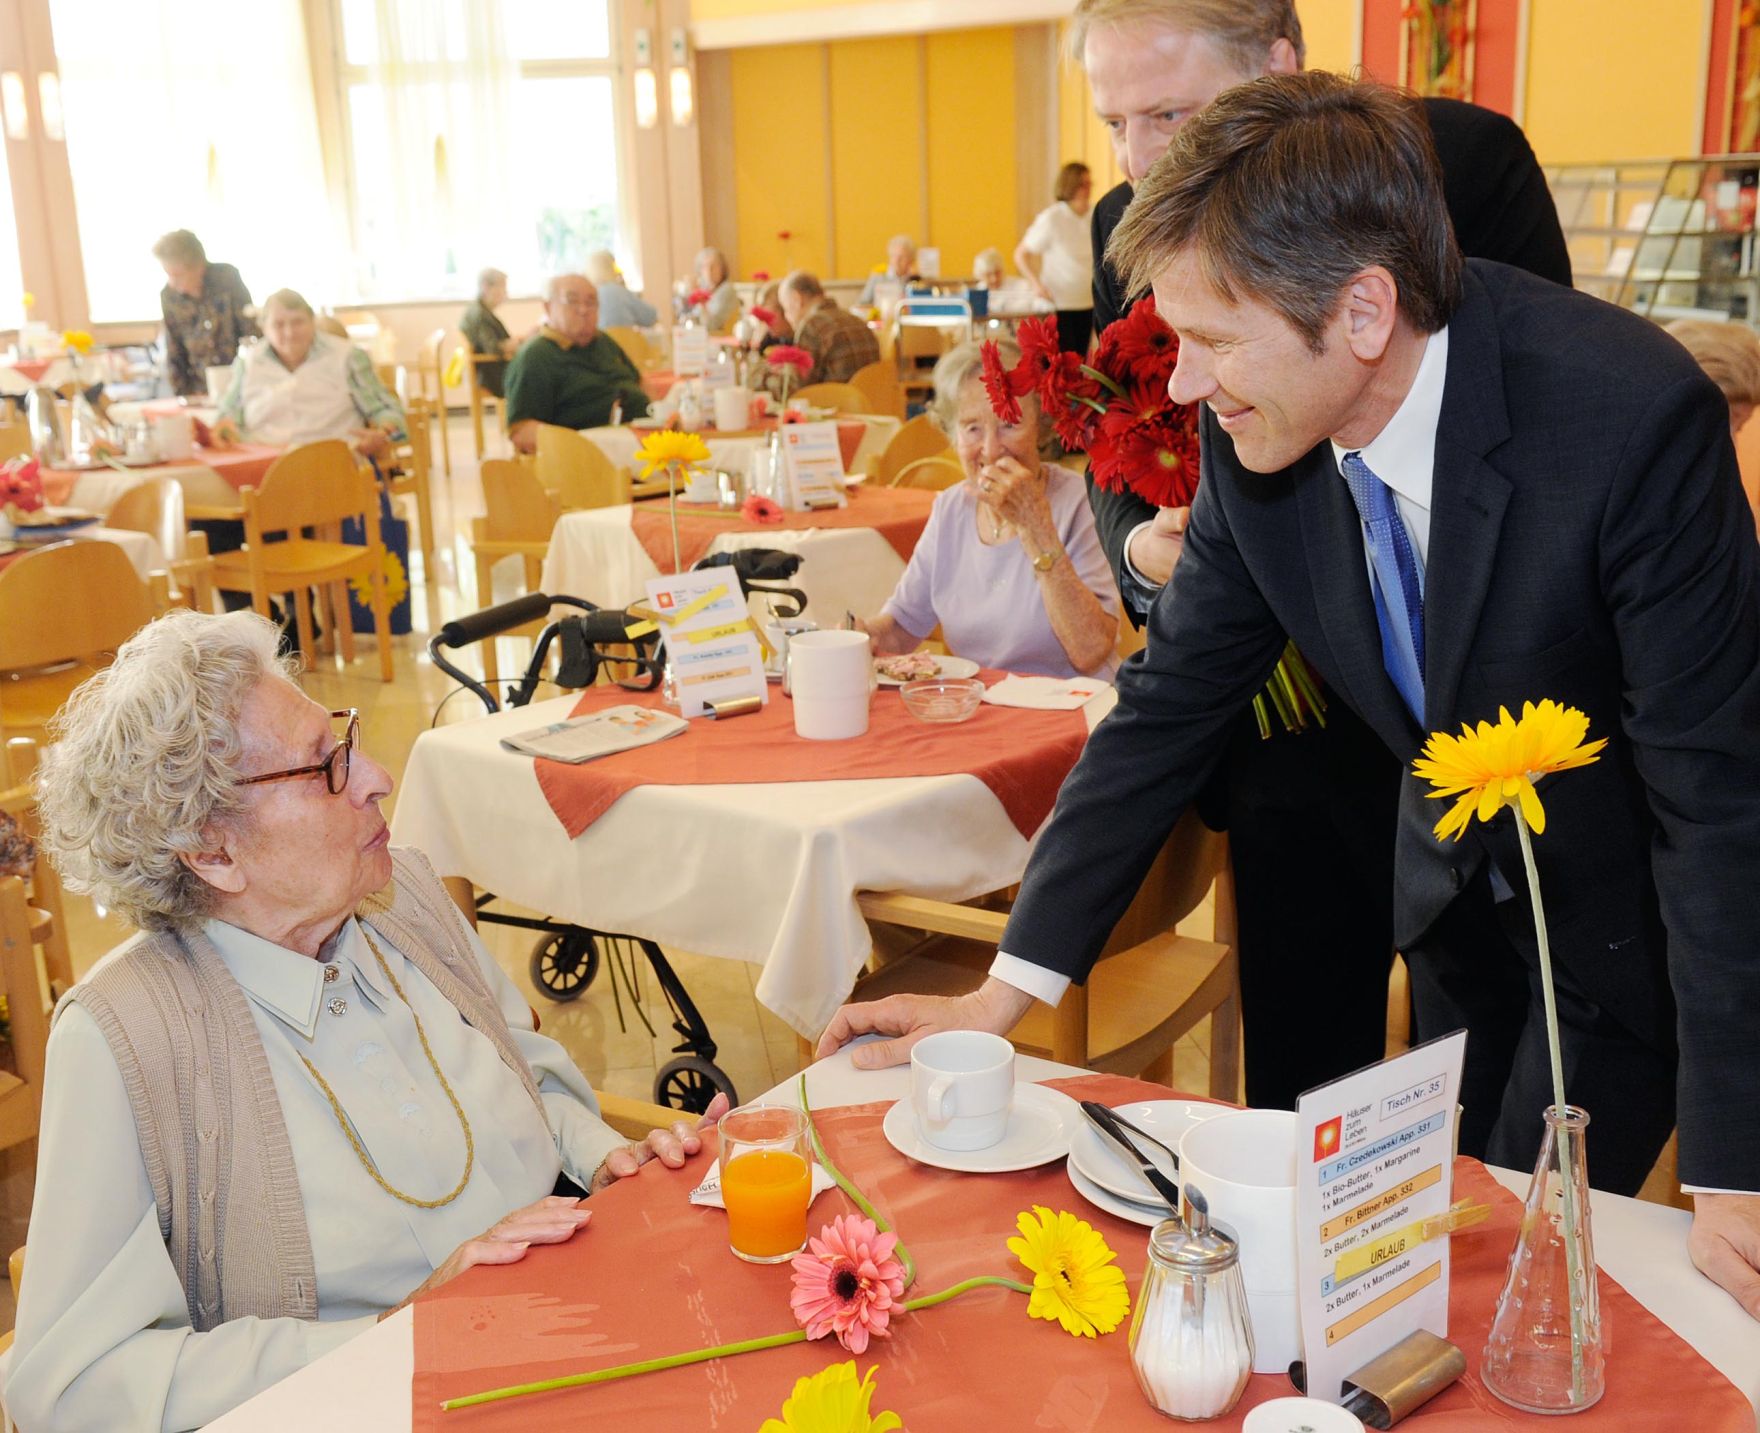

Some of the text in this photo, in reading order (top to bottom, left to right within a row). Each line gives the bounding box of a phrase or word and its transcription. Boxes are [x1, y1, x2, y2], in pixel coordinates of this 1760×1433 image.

[1346, 1103, 1373, 1120] Häuser
[1387, 1081, 1440, 1112] Tisch Nr. 35
[1345, 1126, 1368, 1141] Leben
[1346, 1119, 1362, 1131] zum
[1322, 1171, 1327, 1179] 1
[1336, 1162, 1347, 1173] Fr.
[1399, 1130, 1415, 1145] App.
[1417, 1122, 1431, 1134] 331
[1322, 1146, 1421, 1200] 1x Bio-Butter, 1x Margarine
[1322, 1182, 1374, 1212] 1x Marmelade
[1323, 1182, 1414, 1237] 2 Fr. Bittner App. 332
[1323, 1206, 1409, 1258] 2x Butter, 2x Marmelade
[1370, 1239, 1406, 1265] URLAUB
[1324, 1281, 1330, 1291] 3
[1325, 1259, 1411, 1313] 2x Butter, 1x Marmelade
[1328, 1330, 1335, 1340] 4
